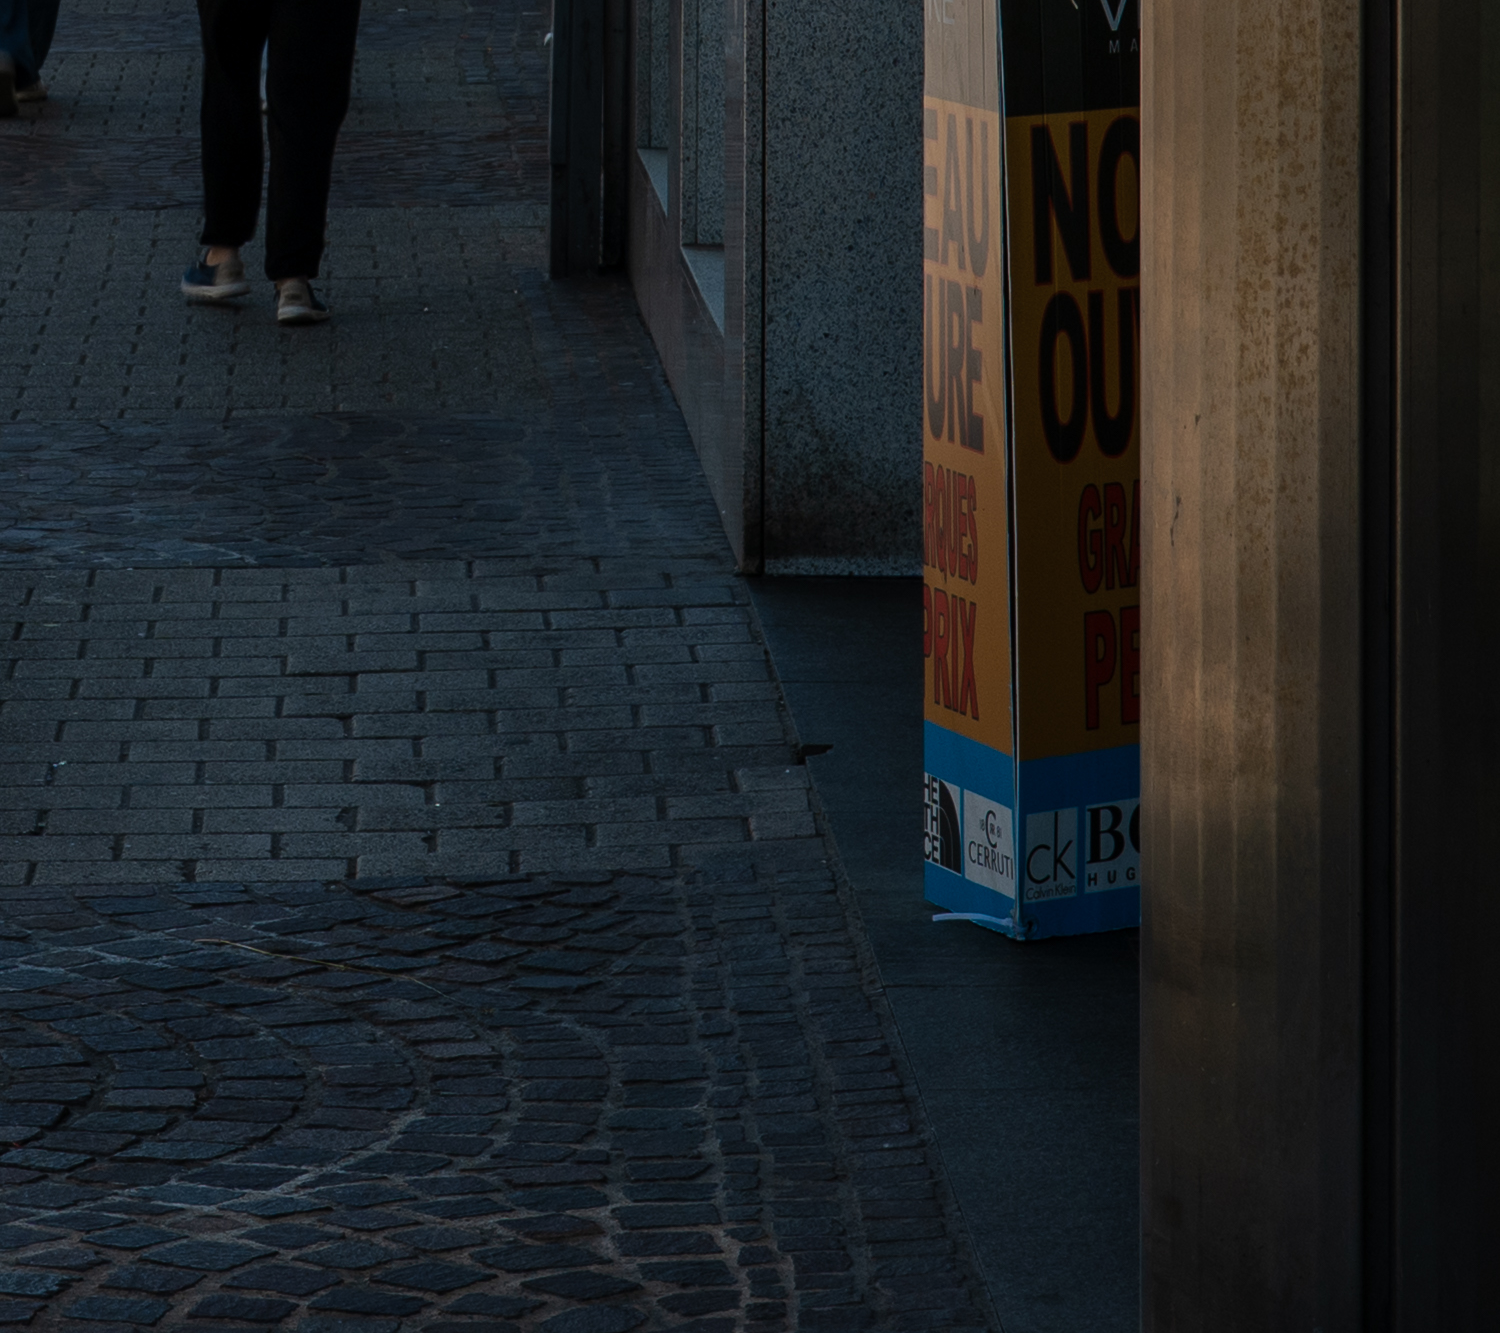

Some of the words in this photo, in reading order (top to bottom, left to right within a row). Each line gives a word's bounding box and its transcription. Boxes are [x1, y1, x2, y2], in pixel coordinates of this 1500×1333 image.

[1038, 288, 1140, 464] OU
[968, 841, 1014, 881] CERRUTI
[1026, 810, 1076, 885] ck
[1026, 887, 1053, 901] Calvin
[1053, 882, 1076, 897] Klein
